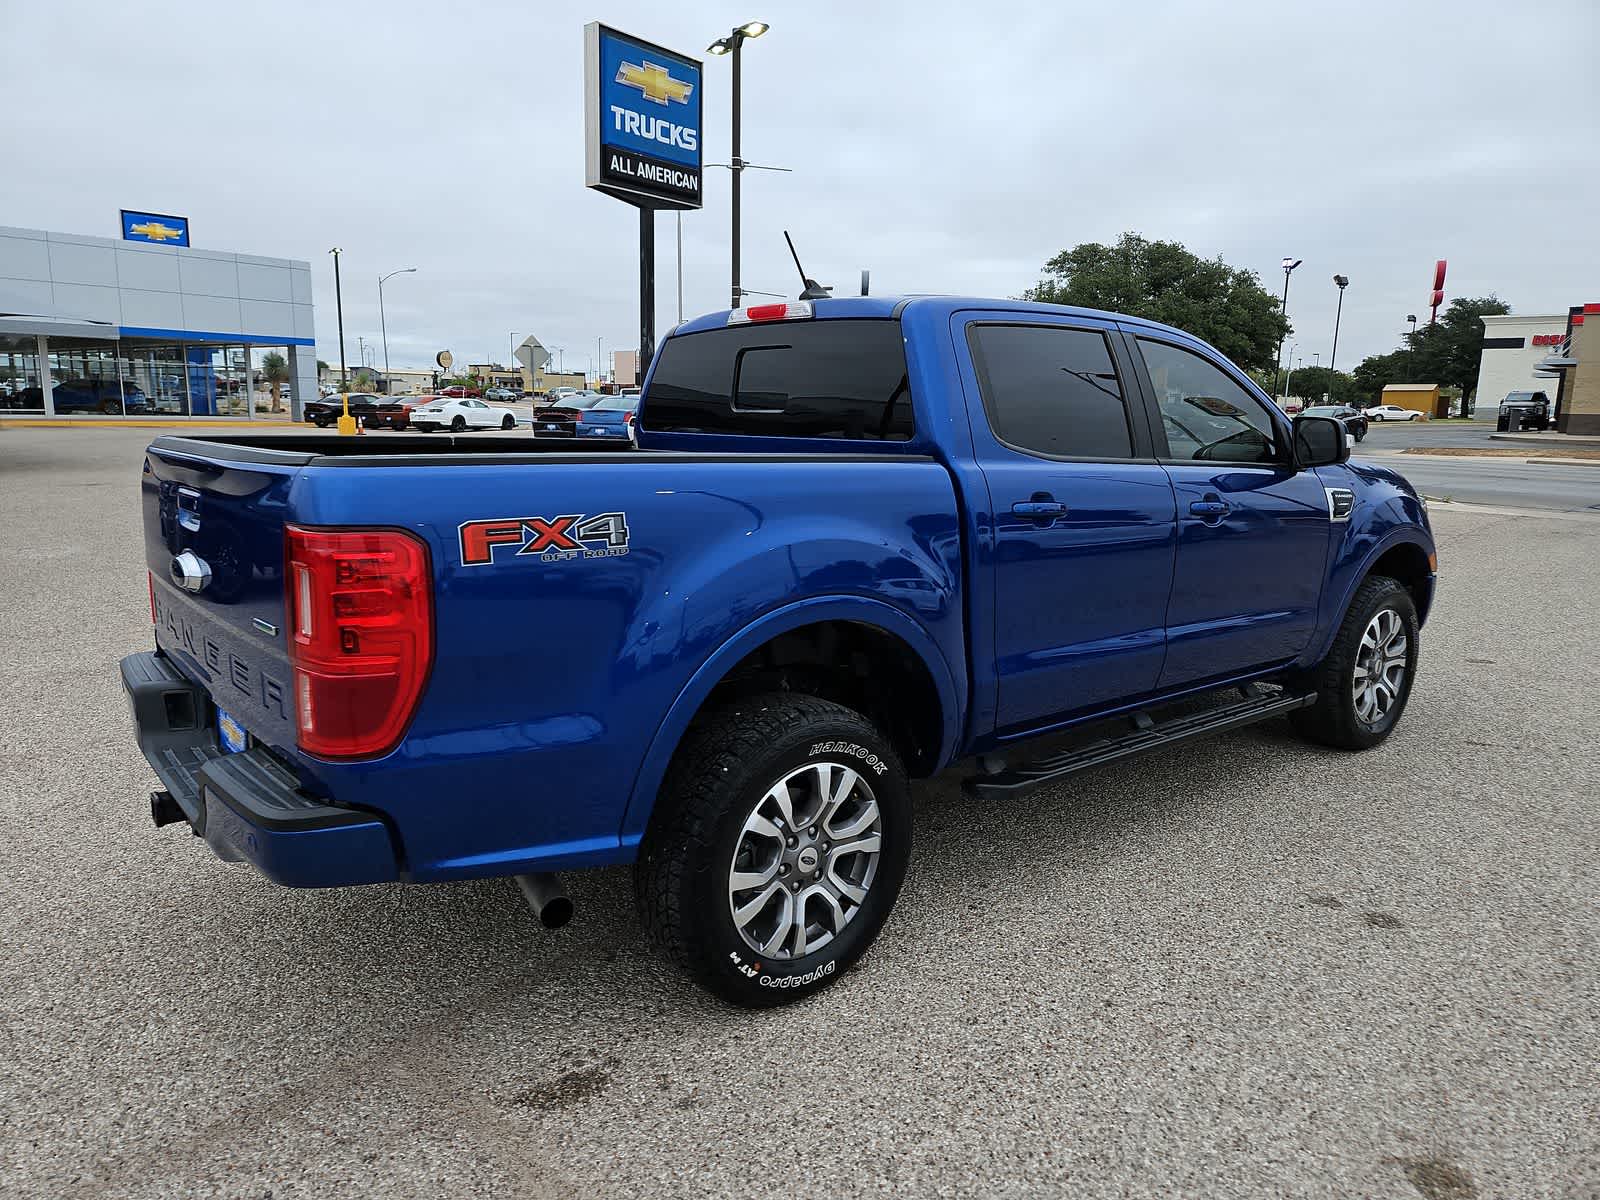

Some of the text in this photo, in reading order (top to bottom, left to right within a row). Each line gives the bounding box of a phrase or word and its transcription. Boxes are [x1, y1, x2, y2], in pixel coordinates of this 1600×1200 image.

[610, 104, 697, 151] TRUCKS
[610, 154, 699, 191] ALL AMERICAN
[457, 511, 631, 567] FX4
[541, 547, 630, 563] OFF ROAD
[759, 959, 836, 988] Dynapro
